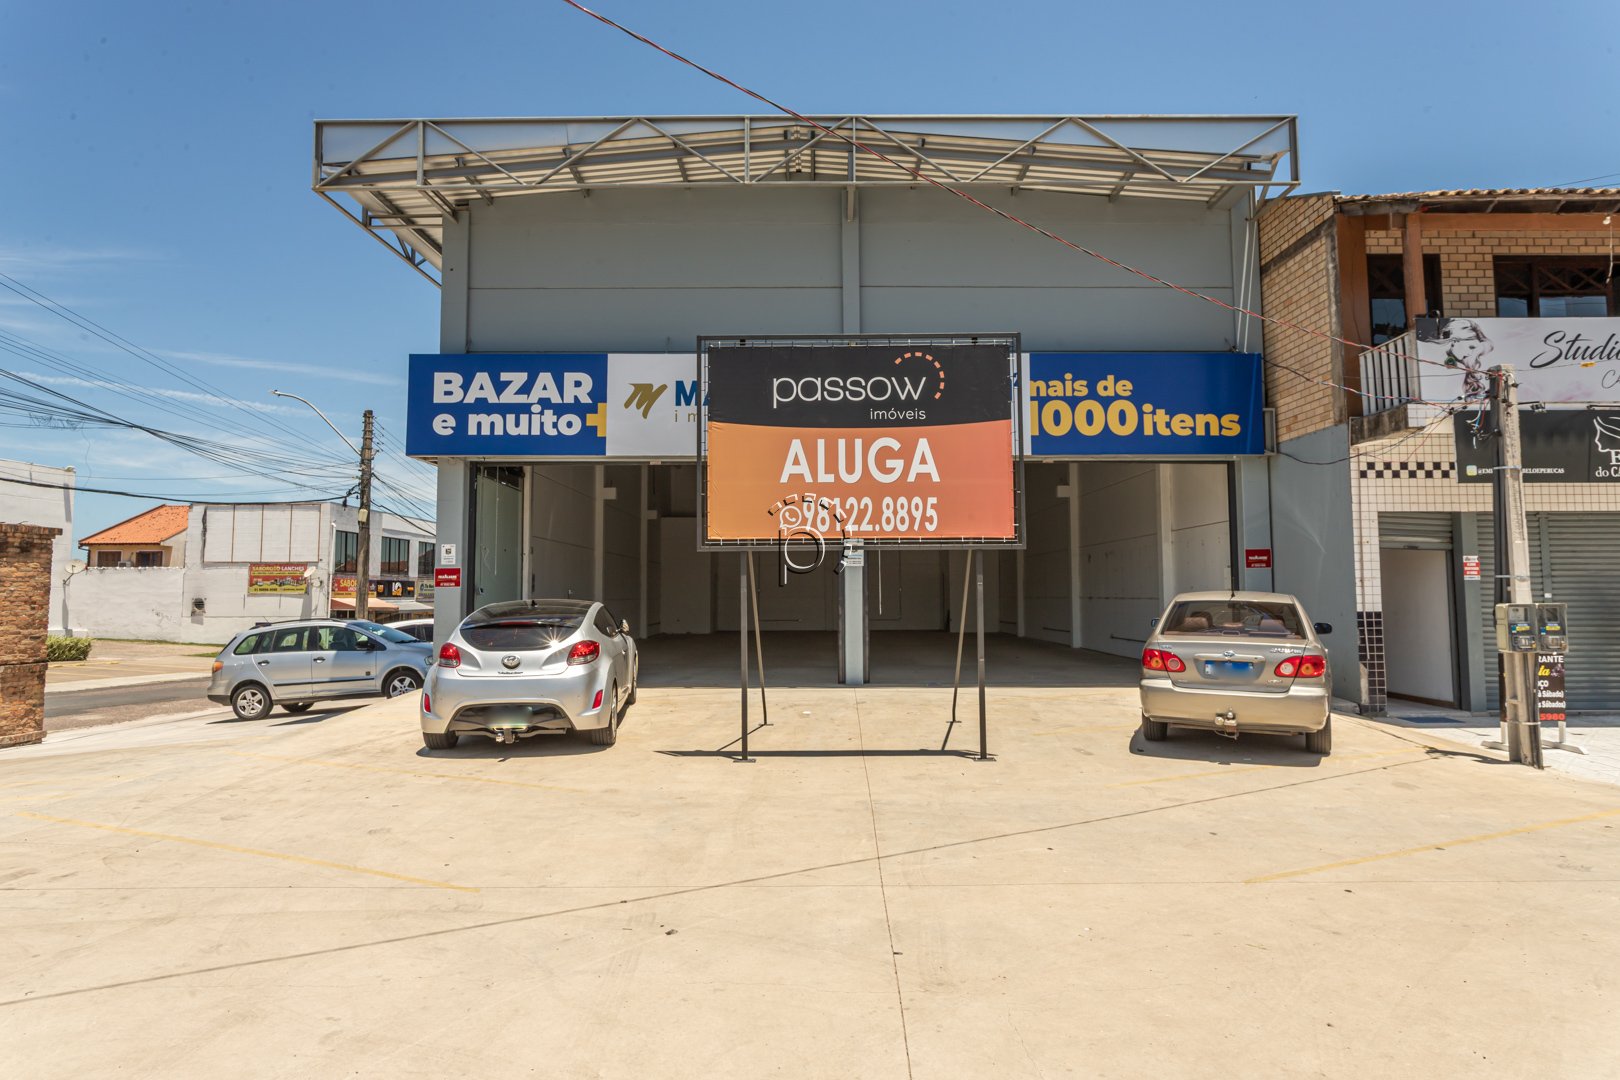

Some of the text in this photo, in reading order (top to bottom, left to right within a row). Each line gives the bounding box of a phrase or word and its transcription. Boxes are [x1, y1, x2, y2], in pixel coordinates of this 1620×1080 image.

[433, 371, 593, 404] BAZAR
[772, 376, 927, 409] passow
[1096, 375, 1133, 397] de
[432, 413, 456, 436] e
[869, 407, 927, 420] imóveis
[1142, 403, 1242, 437] itens
[779, 436, 941, 484] ALUGA
[1595, 466, 1609, 477] do
